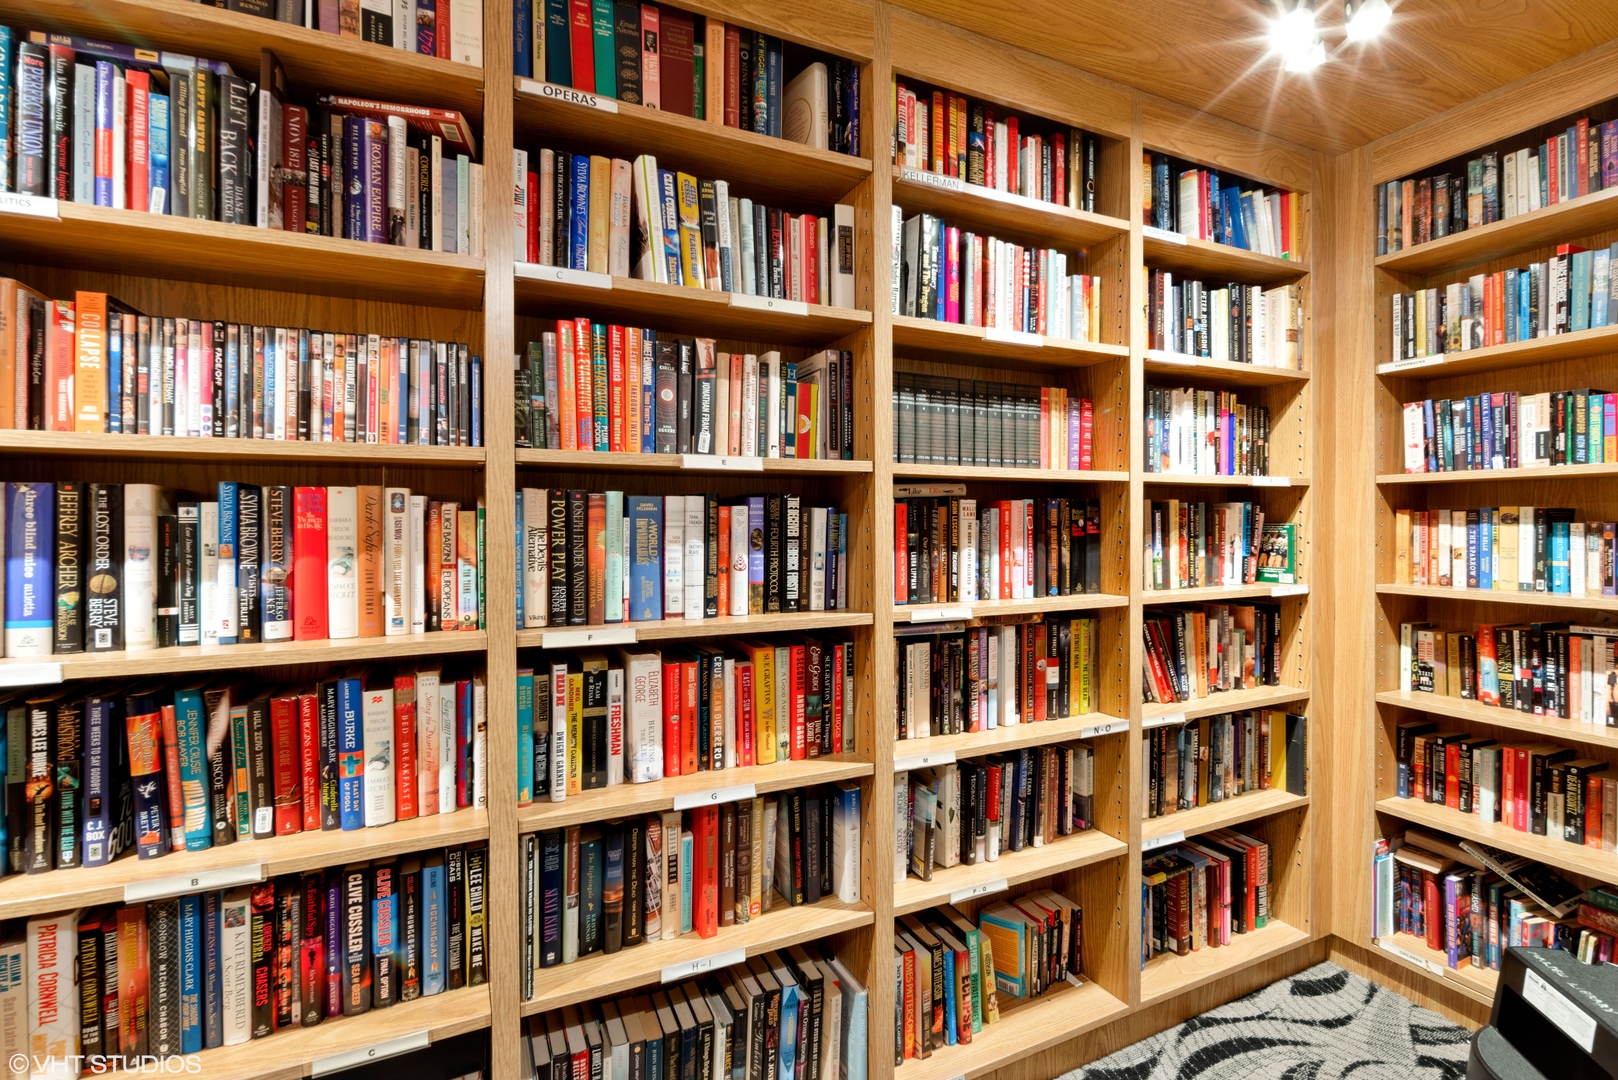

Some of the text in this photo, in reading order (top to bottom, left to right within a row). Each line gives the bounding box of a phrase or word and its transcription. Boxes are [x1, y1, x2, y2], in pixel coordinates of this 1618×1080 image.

[420, 29, 434, 56] 1776
[22, 56, 44, 158] More PERFECT UNION
[55, 93, 68, 131] Dershowitz
[197, 73, 205, 152] HAPPY CANYON
[338, 98, 430, 116] NAPOLEON'S HEMORRHOIDS
[543, 86, 597, 107] OPERAS
[134, 88, 145, 165] WHAT LIBERAL MEDIA?
[220, 82, 248, 176] LEFT BACK
[288, 107, 300, 168] UNION 1812
[225, 178, 243, 218] DIANE RAVITCH
[372, 142, 381, 231] ROMAN EMPIRE
[664, 173, 675, 230] CLIVE CUSSLER
[904, 170, 959, 189] KELLERMAN
[557, 271, 563, 279] C
[80, 313, 101, 370] COLLAPSE
[214, 347, 223, 386] FACE/OFF
[594, 334, 605, 363] JANET
[58, 379, 67, 422] YANIS VAROUFAKIS
[594, 363, 607, 417] EVANOVICH
[58, 490, 78, 590] JEFFREY ARCHER
[97, 496, 109, 571] THE LOST ORDER
[223, 485, 233, 543] SYLVIA BROWNE
[365, 494, 380, 565] Dark Safari
[443, 509, 452, 563] LUIGI BARZINI
[538, 527, 547, 541] The
[552, 500, 566, 582] POWER PLAY
[23, 489, 37, 617] three blind mice auletta
[528, 526, 537, 572] Alternative
[573, 500, 584, 615] JOSEPH FINDER VANISHED
[88, 598, 118, 628] STEVE BERRY
[240, 588, 248, 626] AFTERLIFE
[442, 571, 451, 618] EUROPEANS
[635, 671, 659, 706] ELIZABETH GEORGE
[32, 710, 47, 777] JAMES LEE BURKE
[57, 710, 74, 760] ARMSTRONG
[253, 711, 264, 777] HULL ZERO THREE
[345, 710, 356, 749] BURKE
[611, 705, 621, 756] FRESHMAN
[714, 714, 722, 759] GUERRERO
[212, 751, 224, 790] BRISCOE
[182, 780, 207, 833] WILD RIDE
[86, 830, 105, 840] BOX
[752, 840, 761, 899] DOWN RIVER
[348, 874, 362, 953] CLIVE CUSSLER
[430, 903, 438, 960] MOCKINGJAY
[470, 868, 482, 968] LEE CHILD MAKE ME
[1489, 905, 1499, 943] SWINDLE
[38, 924, 59, 1026] PATRICIA CORNWELL
[158, 910, 168, 1040] MOONGLOW MICHAEL CHABON
[905, 956, 915, 1032] JAMES PATTERSON
[962, 975, 970, 1031] ECLIPSE
